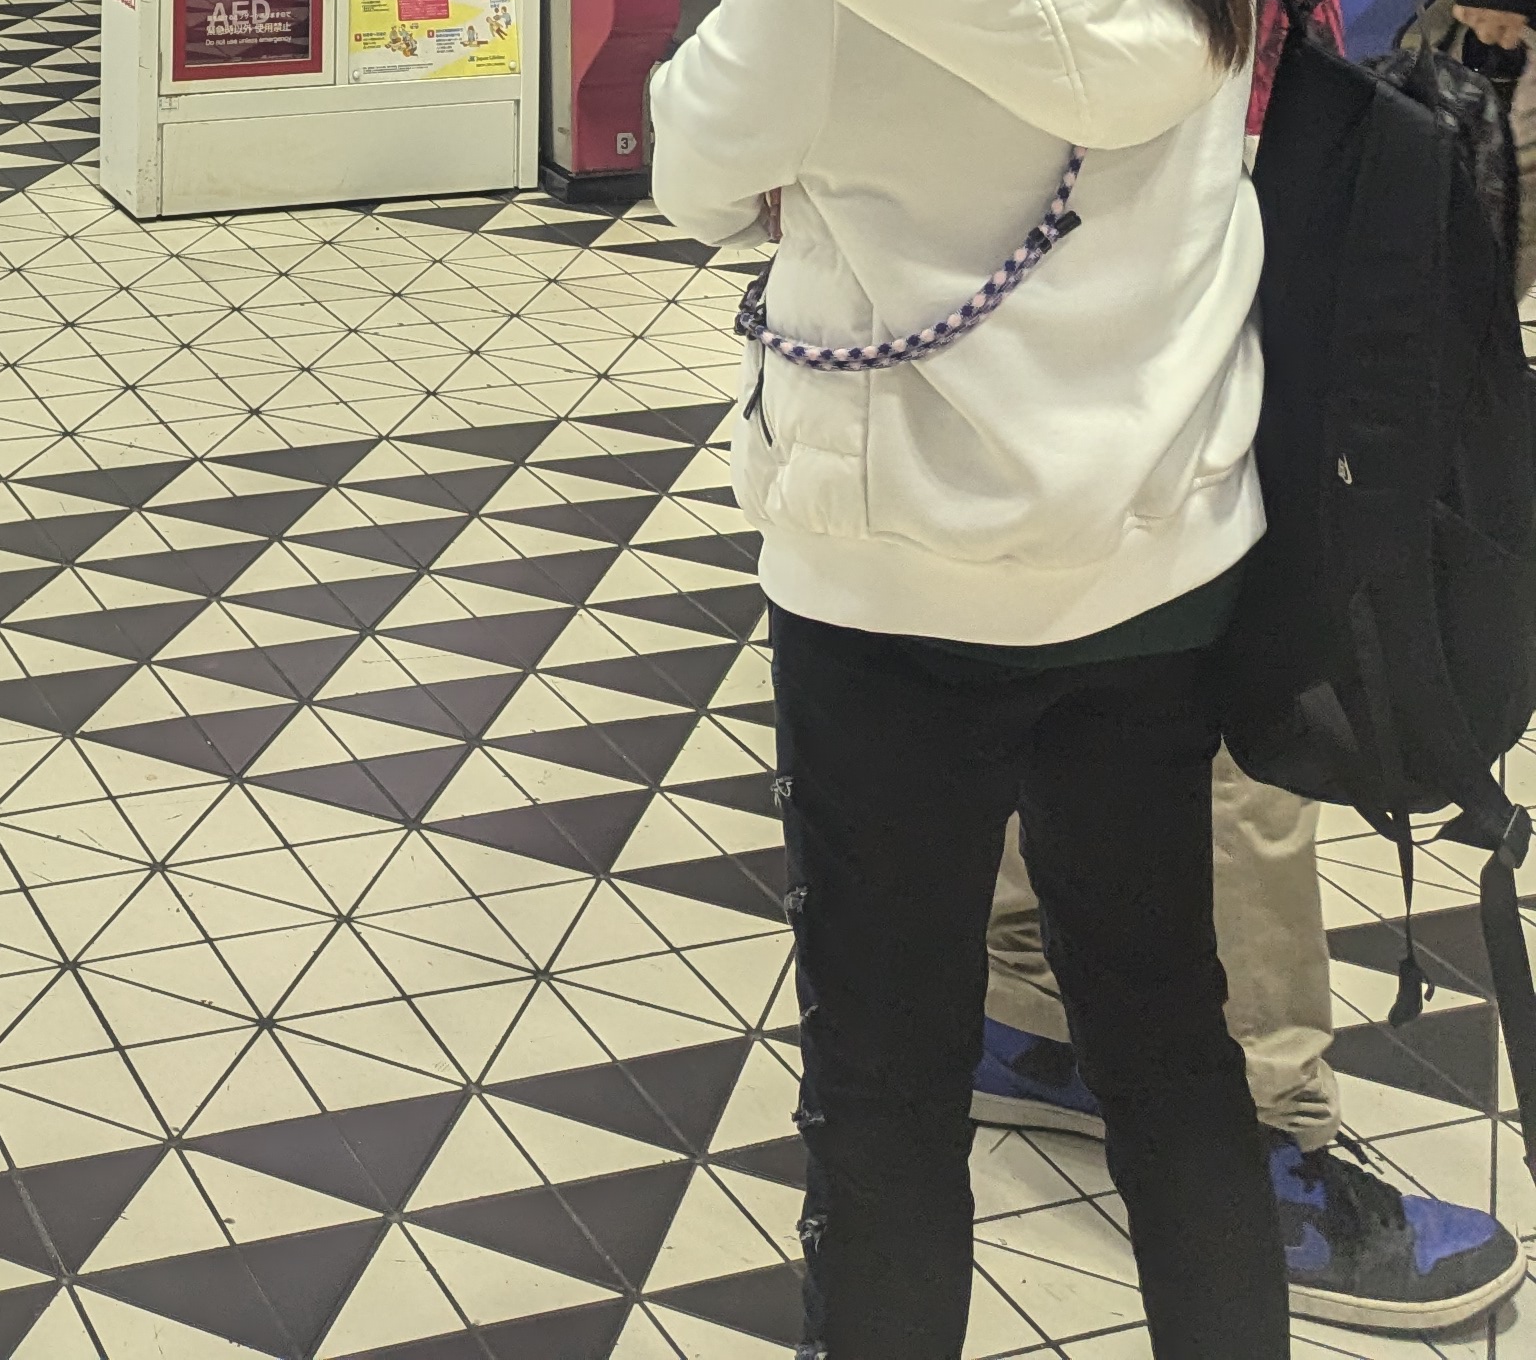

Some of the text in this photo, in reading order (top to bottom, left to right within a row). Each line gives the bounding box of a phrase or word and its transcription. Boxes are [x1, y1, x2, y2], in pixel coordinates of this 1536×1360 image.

[255, 22, 291, 33] 使用禁止
[259, 36, 291, 44] emergency
[621, 138, 629, 149] 3
